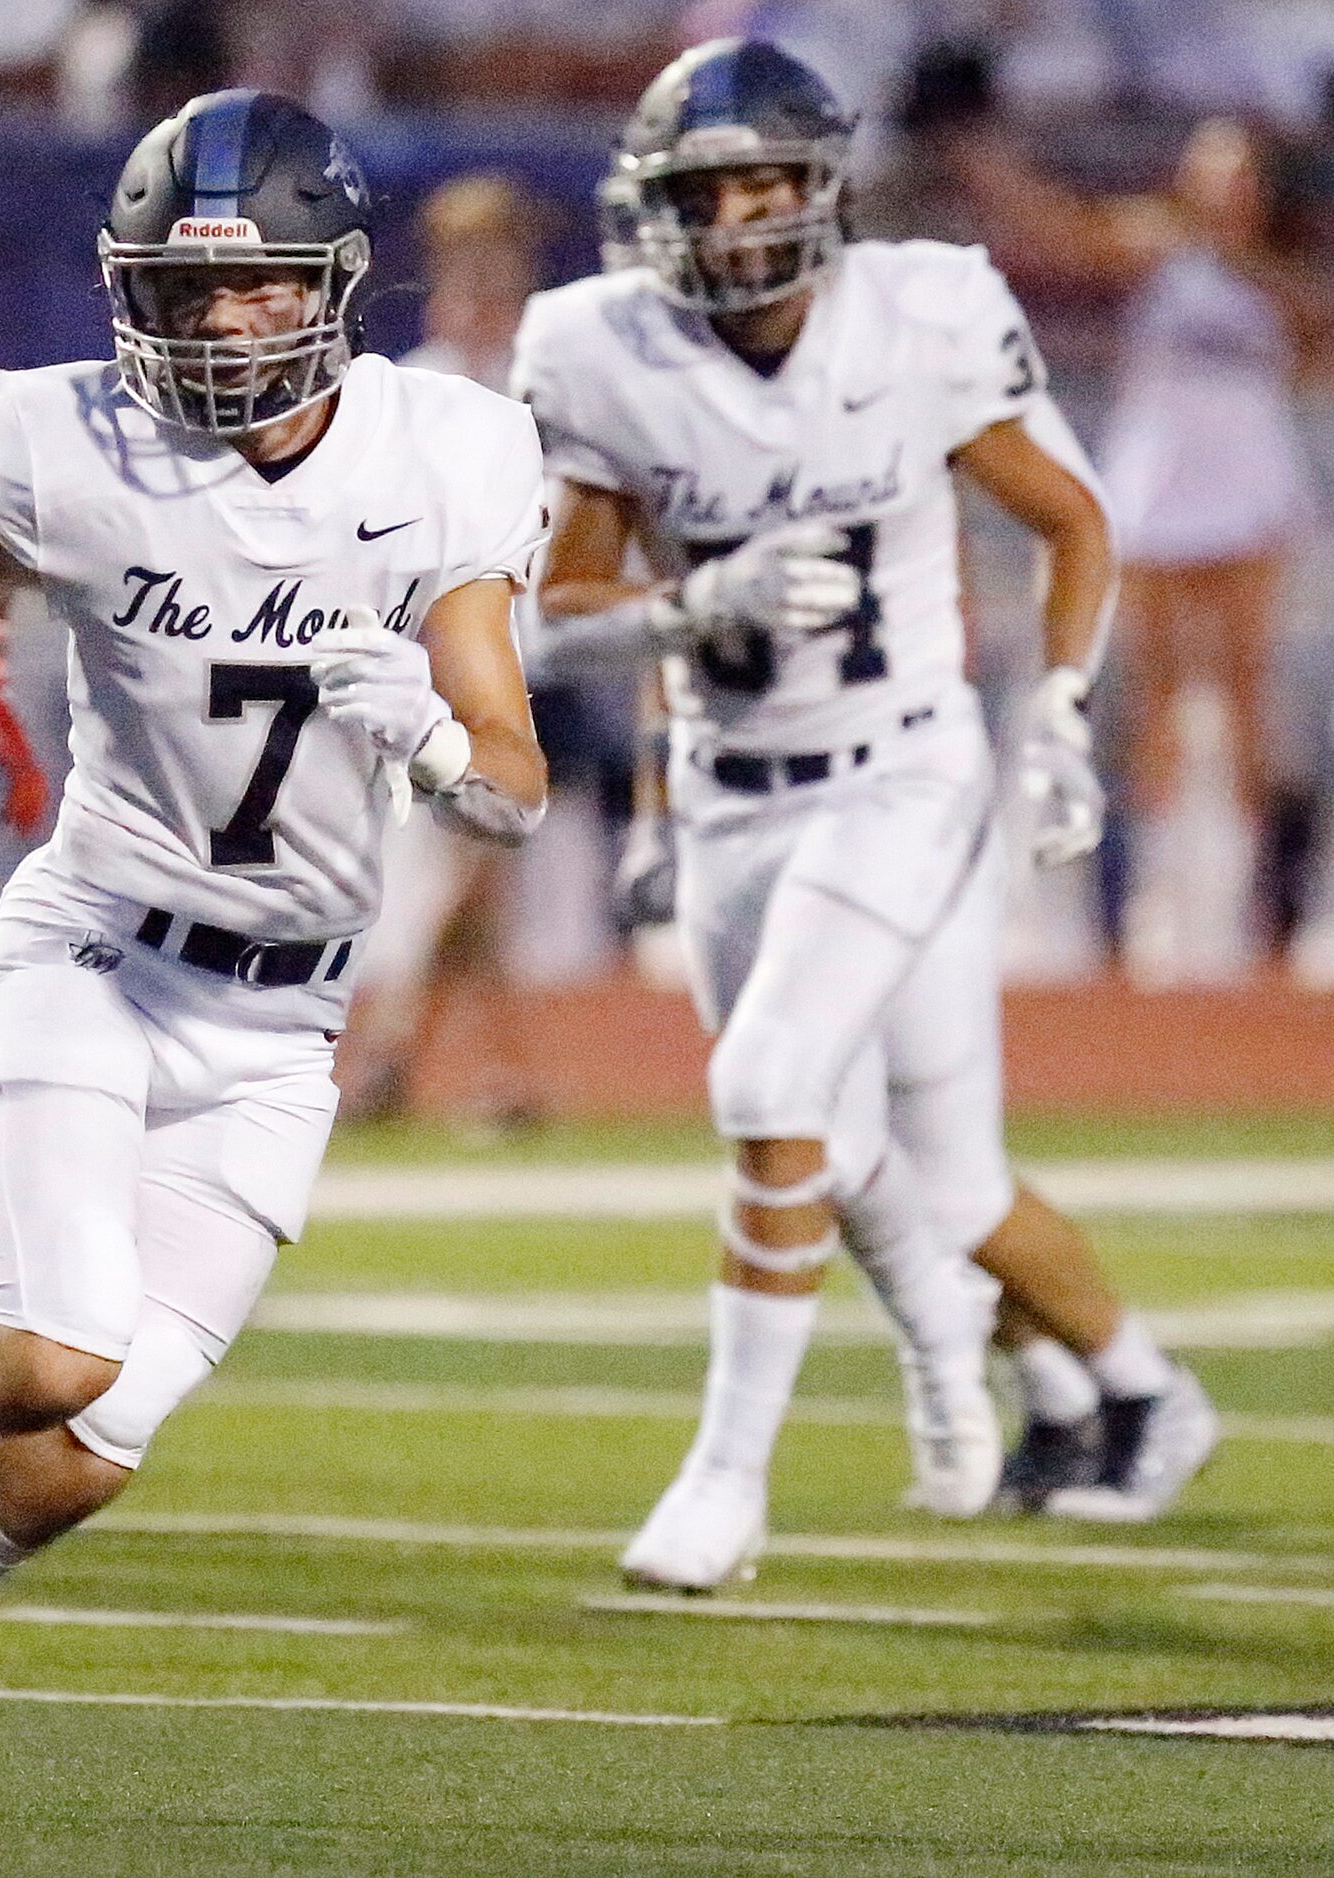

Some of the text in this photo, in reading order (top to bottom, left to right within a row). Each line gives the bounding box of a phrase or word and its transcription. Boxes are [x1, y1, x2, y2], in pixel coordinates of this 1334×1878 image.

[179, 223, 248, 238] Riddell
[112, 565, 422, 648] The Moud
[206, 661, 319, 868] 7
